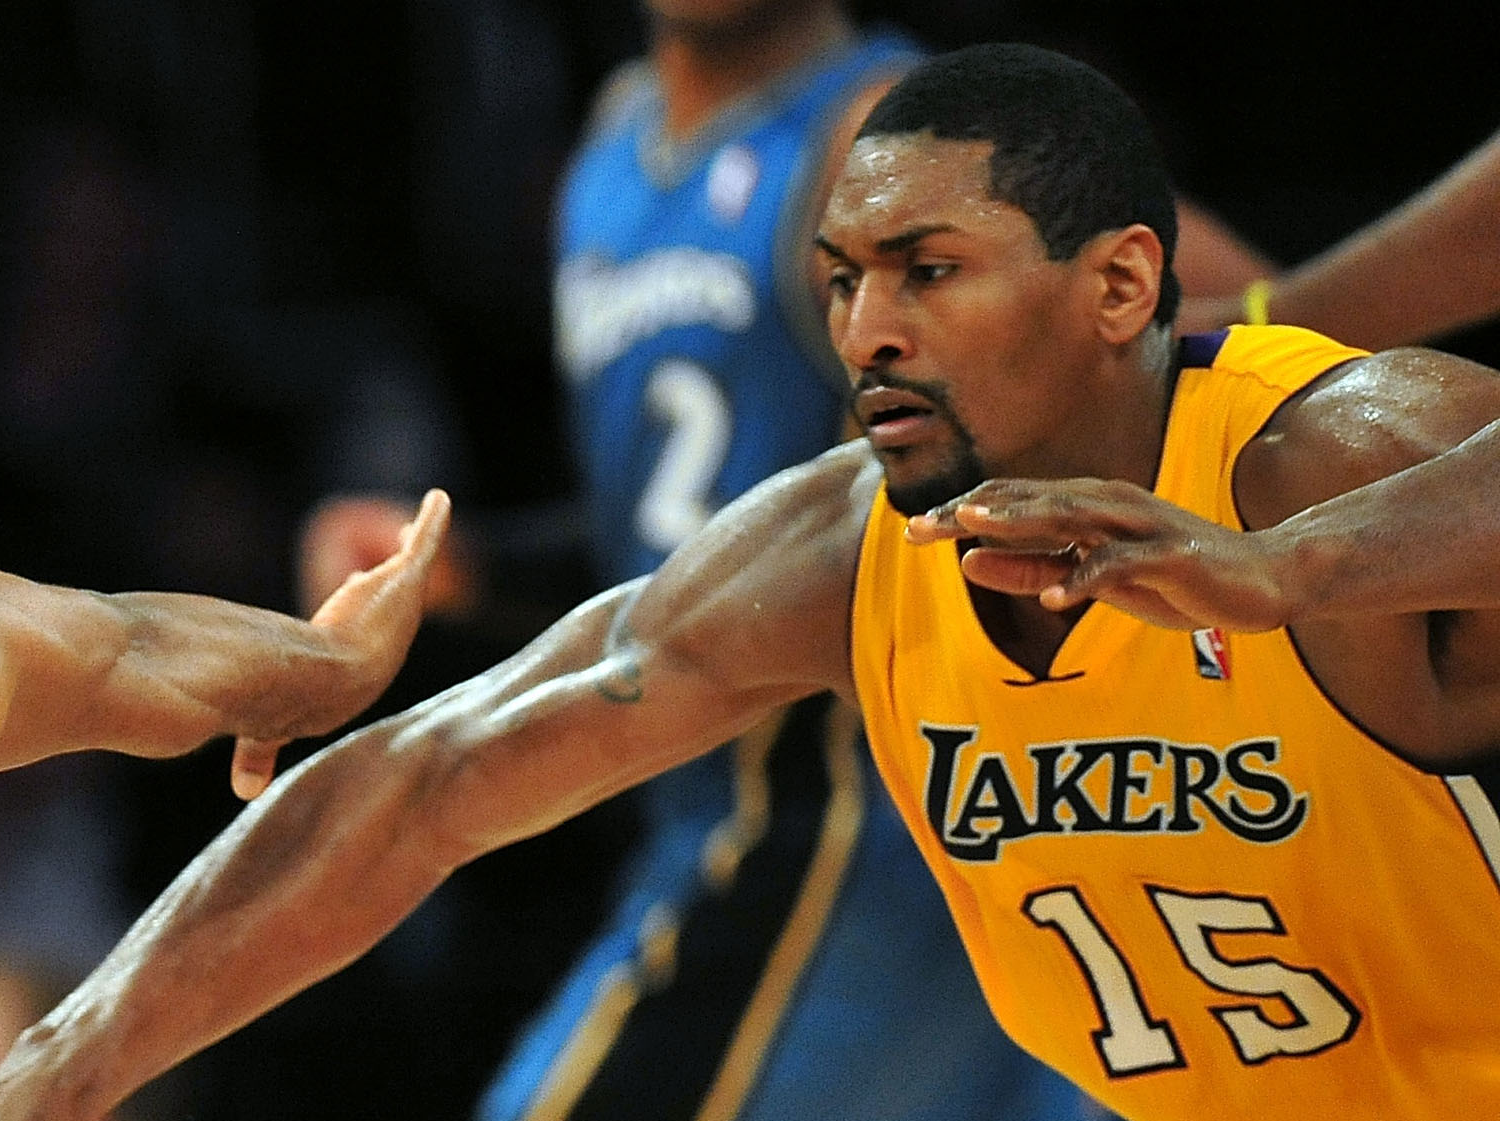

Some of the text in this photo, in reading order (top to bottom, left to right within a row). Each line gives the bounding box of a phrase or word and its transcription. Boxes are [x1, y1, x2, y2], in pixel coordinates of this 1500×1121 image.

[636, 356, 731, 552] 2
[919, 721, 1309, 862] LAKERS
[1021, 883, 1361, 1079] 15
